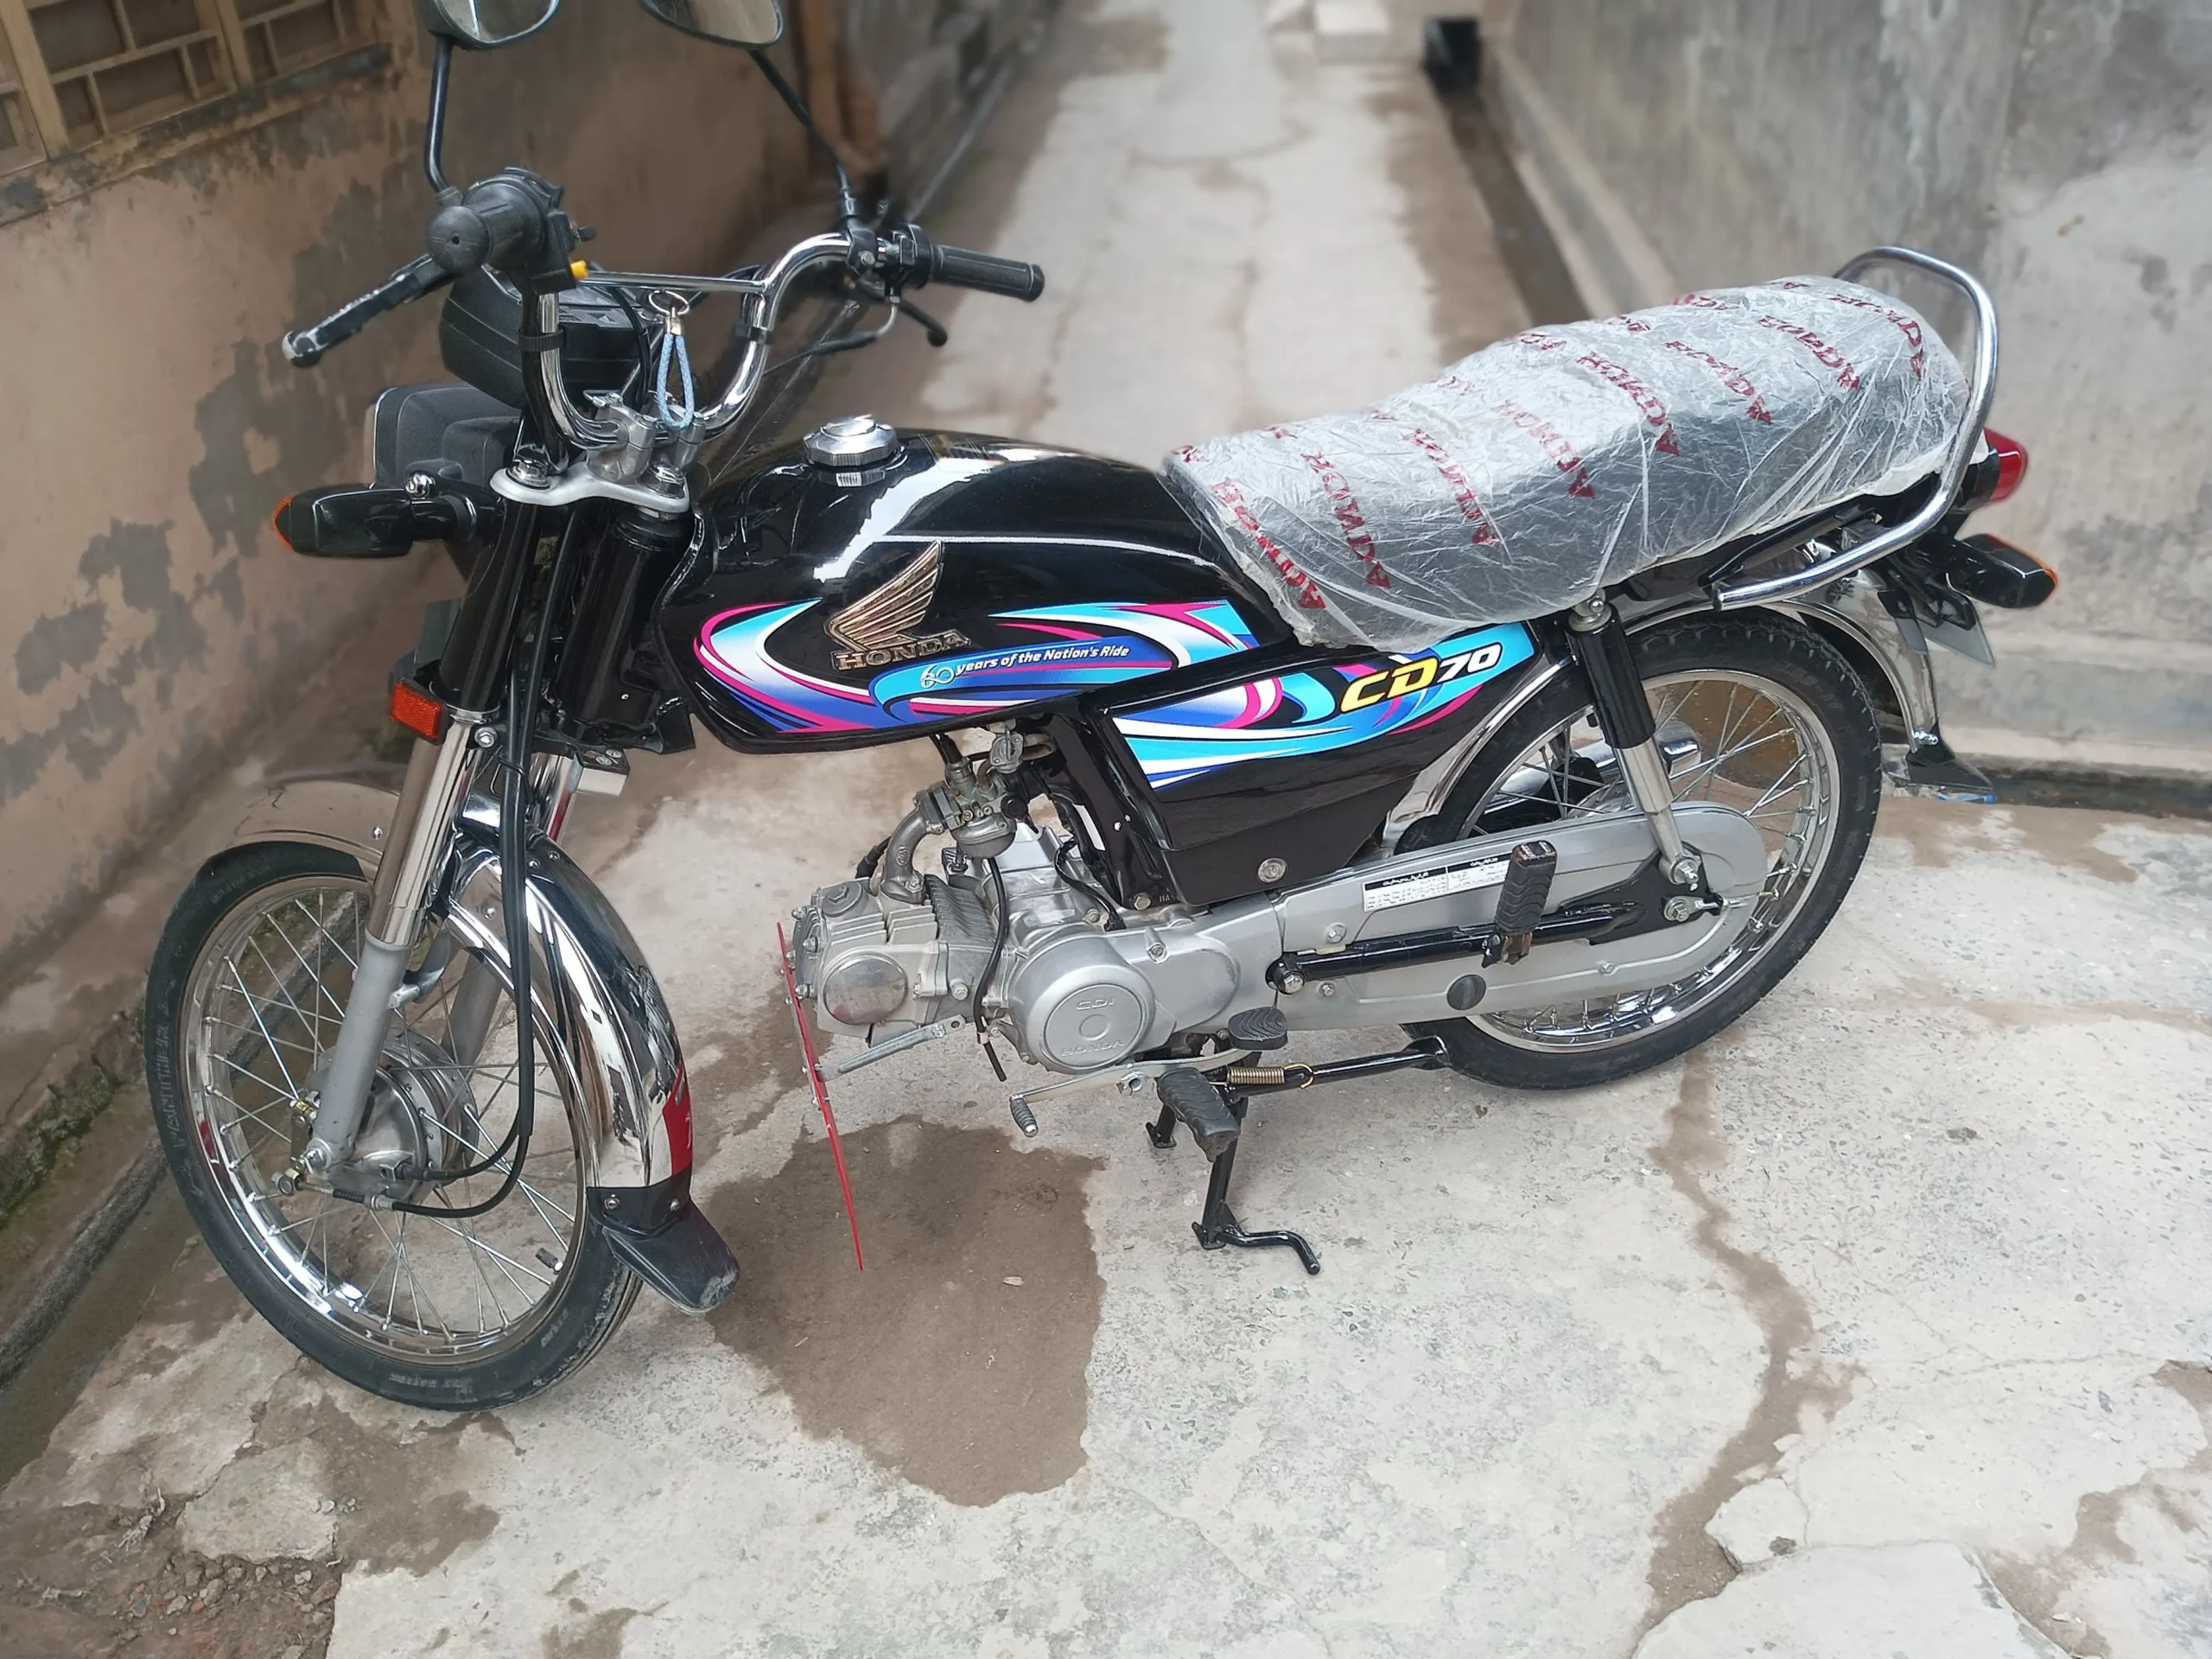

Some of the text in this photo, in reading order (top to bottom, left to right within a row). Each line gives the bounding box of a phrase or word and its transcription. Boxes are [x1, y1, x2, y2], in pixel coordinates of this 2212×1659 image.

[836, 631, 970, 671] HONDA
[919, 645, 1130, 690] 60 years of the Nation's Ride
[1075, 997, 1116, 1011] CDI
[1060, 1039, 1126, 1057] HONDA
